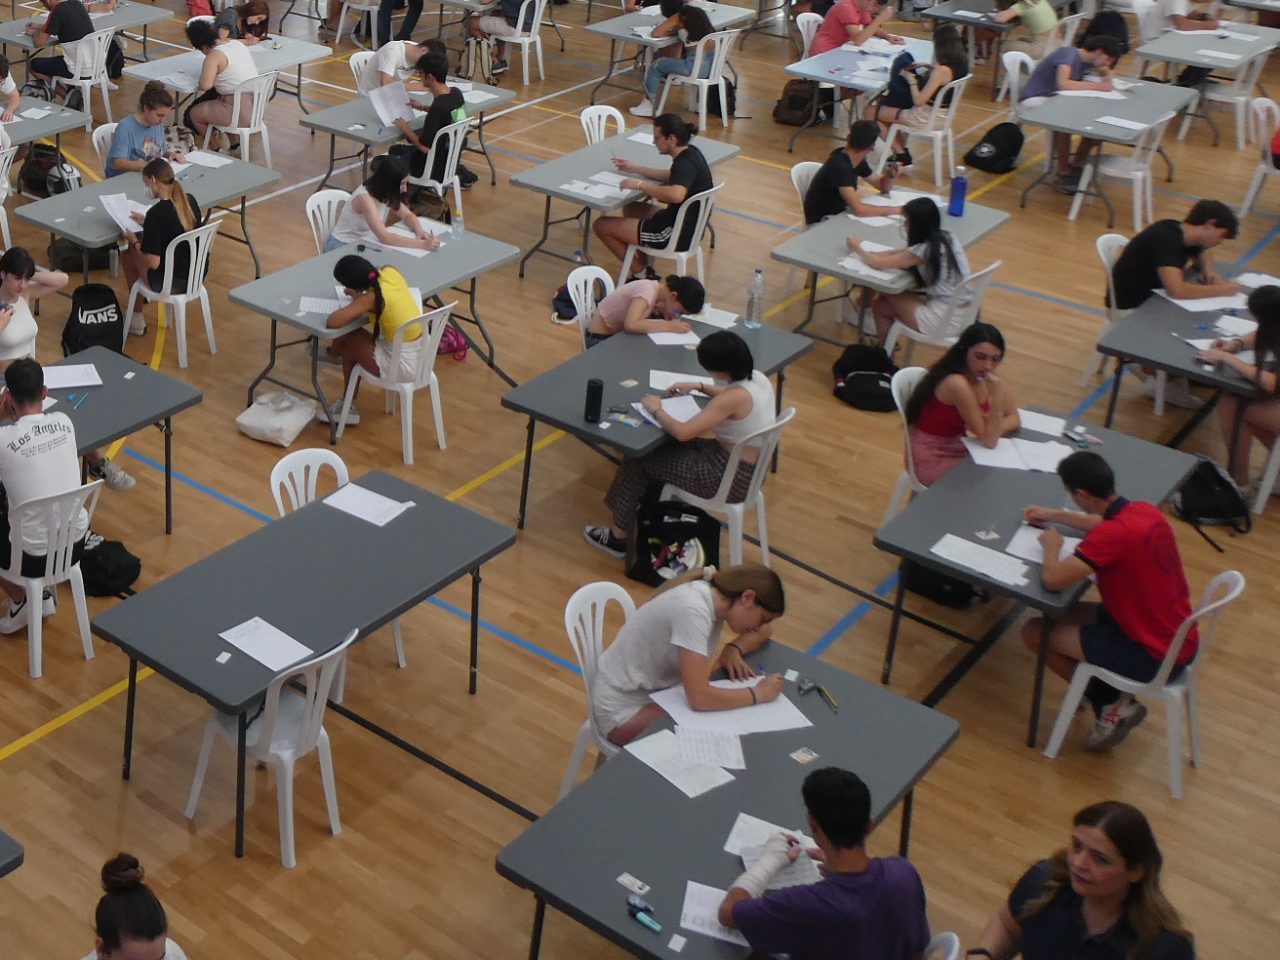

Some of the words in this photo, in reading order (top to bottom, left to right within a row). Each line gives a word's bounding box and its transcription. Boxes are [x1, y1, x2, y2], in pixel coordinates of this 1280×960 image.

[78, 303, 119, 325] VANS
[7, 431, 31, 453] Los
[32, 421, 72, 437] Angeles
